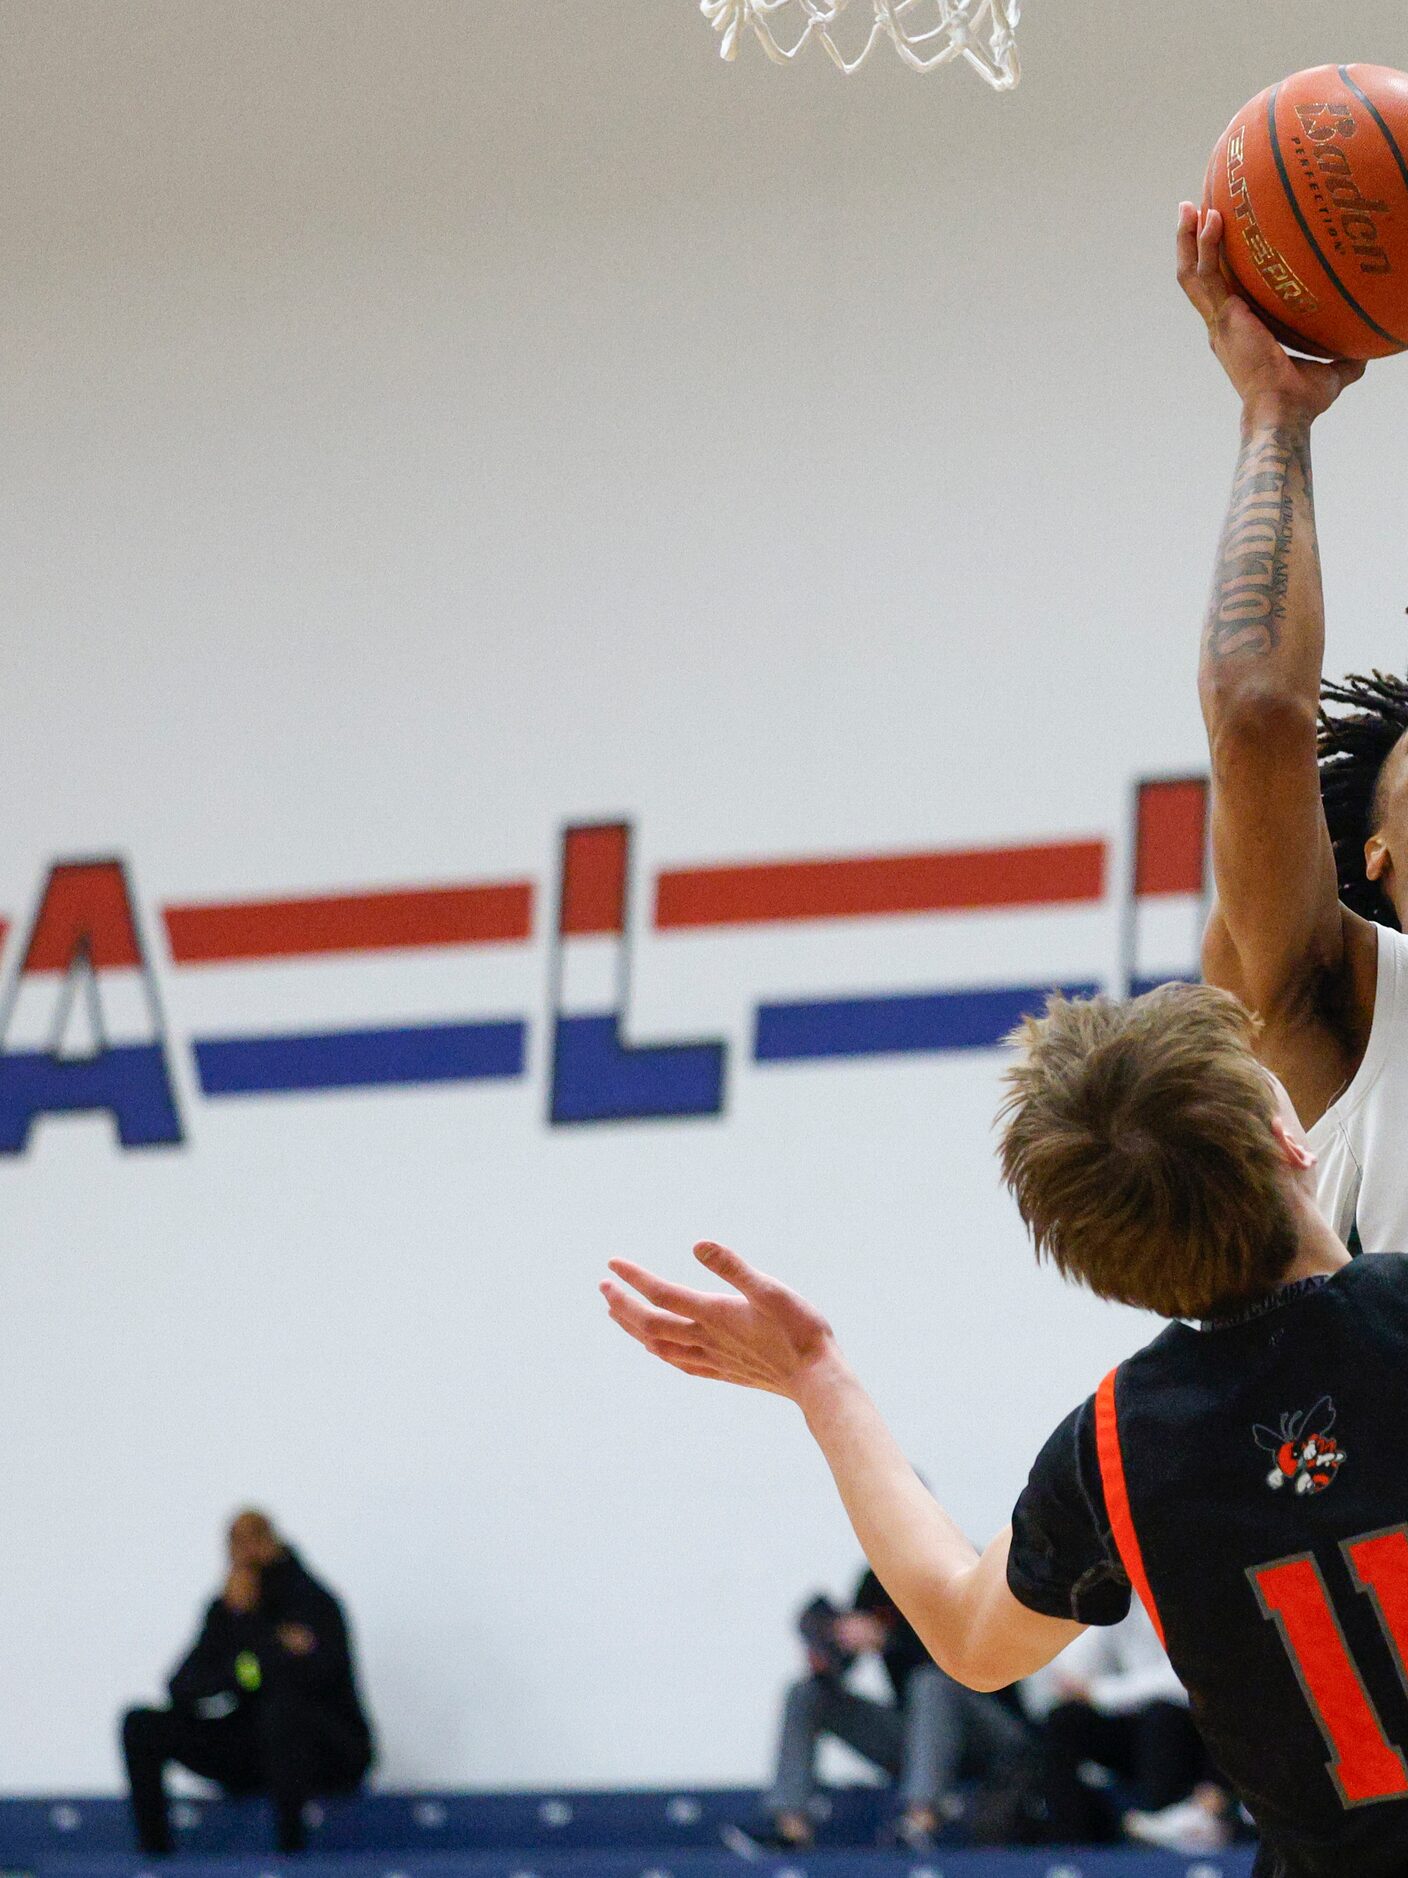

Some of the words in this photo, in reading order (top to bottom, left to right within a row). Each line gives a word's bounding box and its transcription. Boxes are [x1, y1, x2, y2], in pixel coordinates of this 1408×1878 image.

[1227, 125, 1275, 265] ELITE
[1291, 136, 1345, 254] PERFECTION
[1294, 102, 1393, 276] Baden
